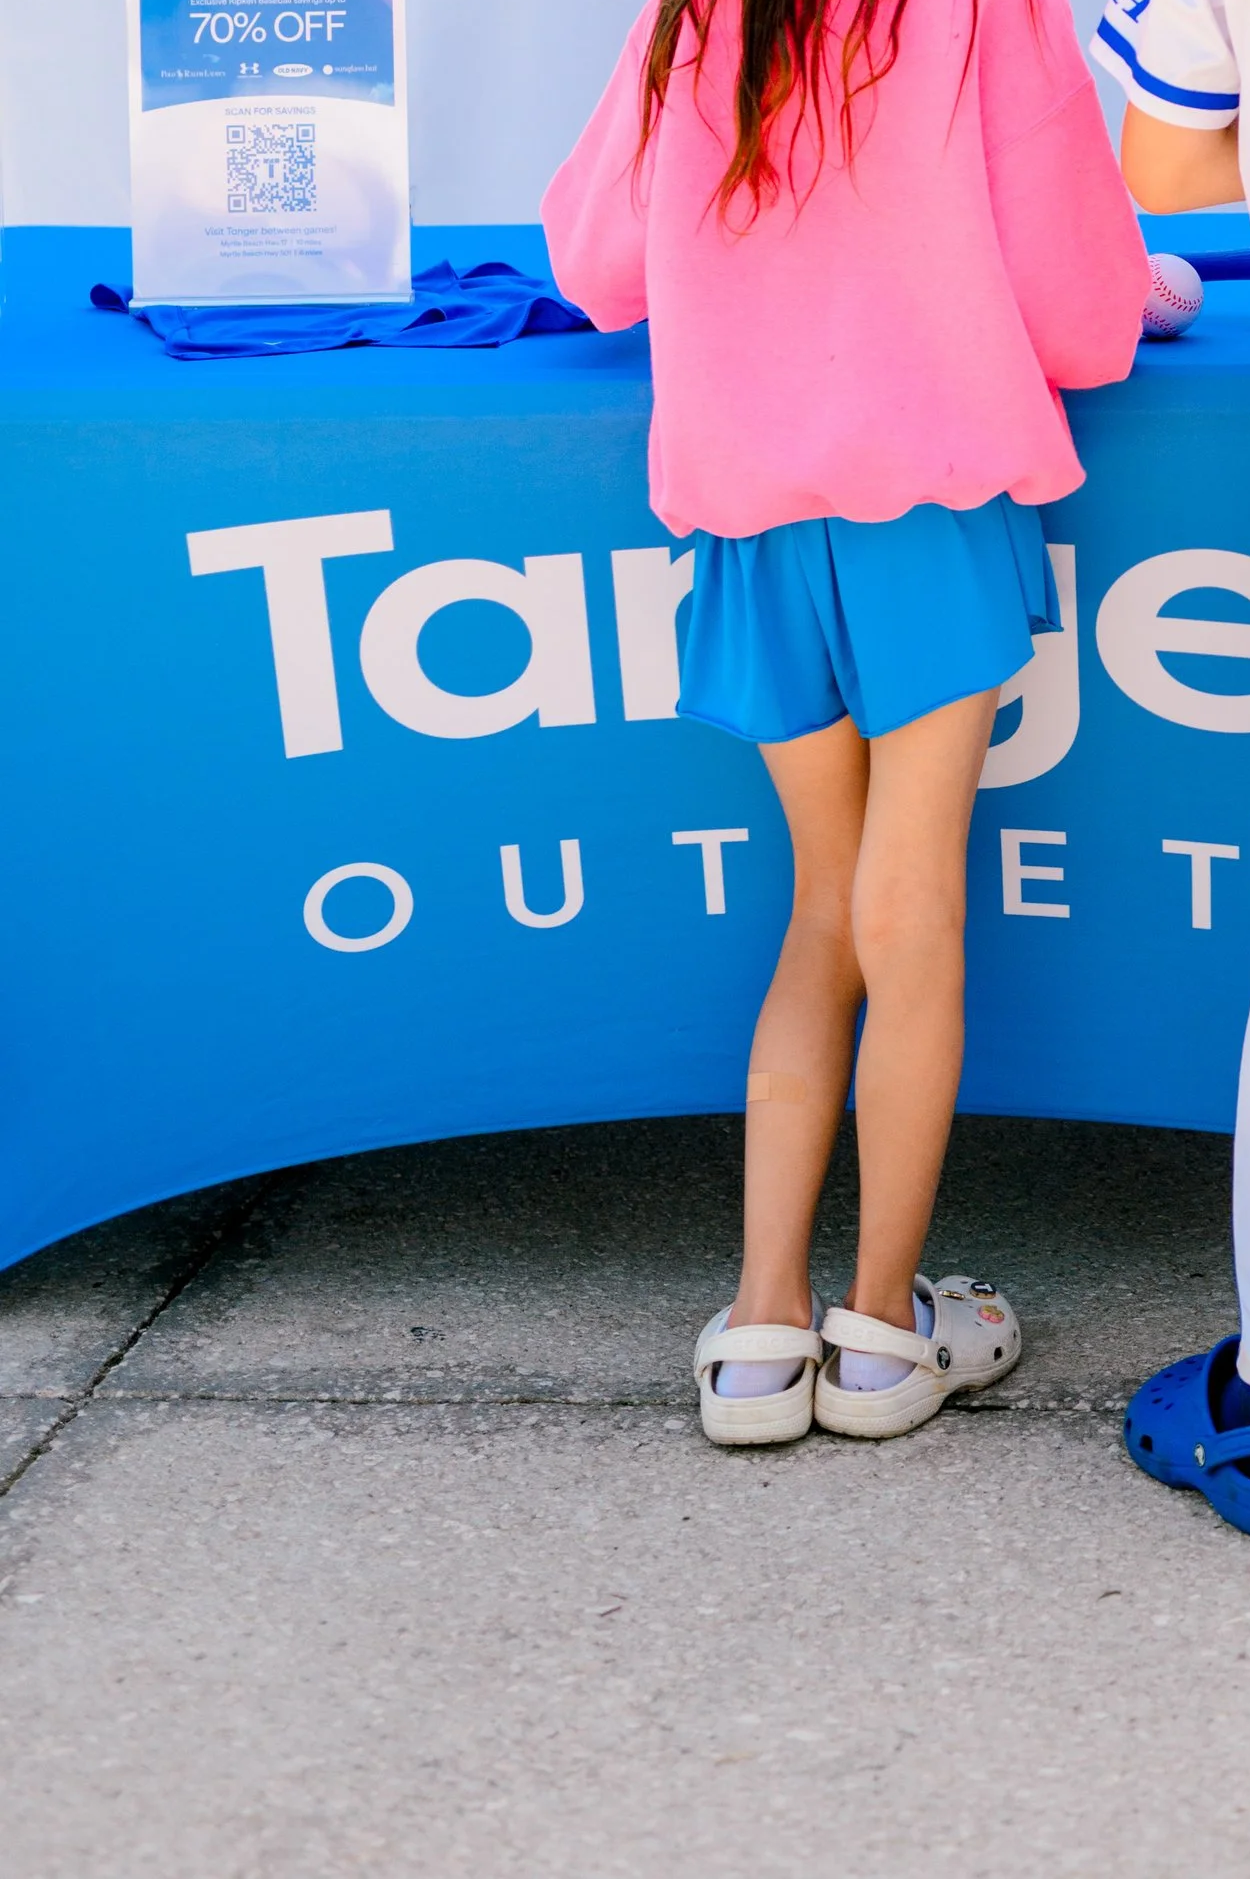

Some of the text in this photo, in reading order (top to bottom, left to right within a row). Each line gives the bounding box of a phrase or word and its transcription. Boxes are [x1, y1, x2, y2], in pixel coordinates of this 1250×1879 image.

[189, 10, 347, 44] 70% OFF
[225, 106, 316, 116] SCAN FOR SAVINGS
[204, 227, 224, 236] Visit
[226, 226, 259, 237] Tanger
[261, 226, 302, 236] between
[303, 827, 1241, 954] OUTET
